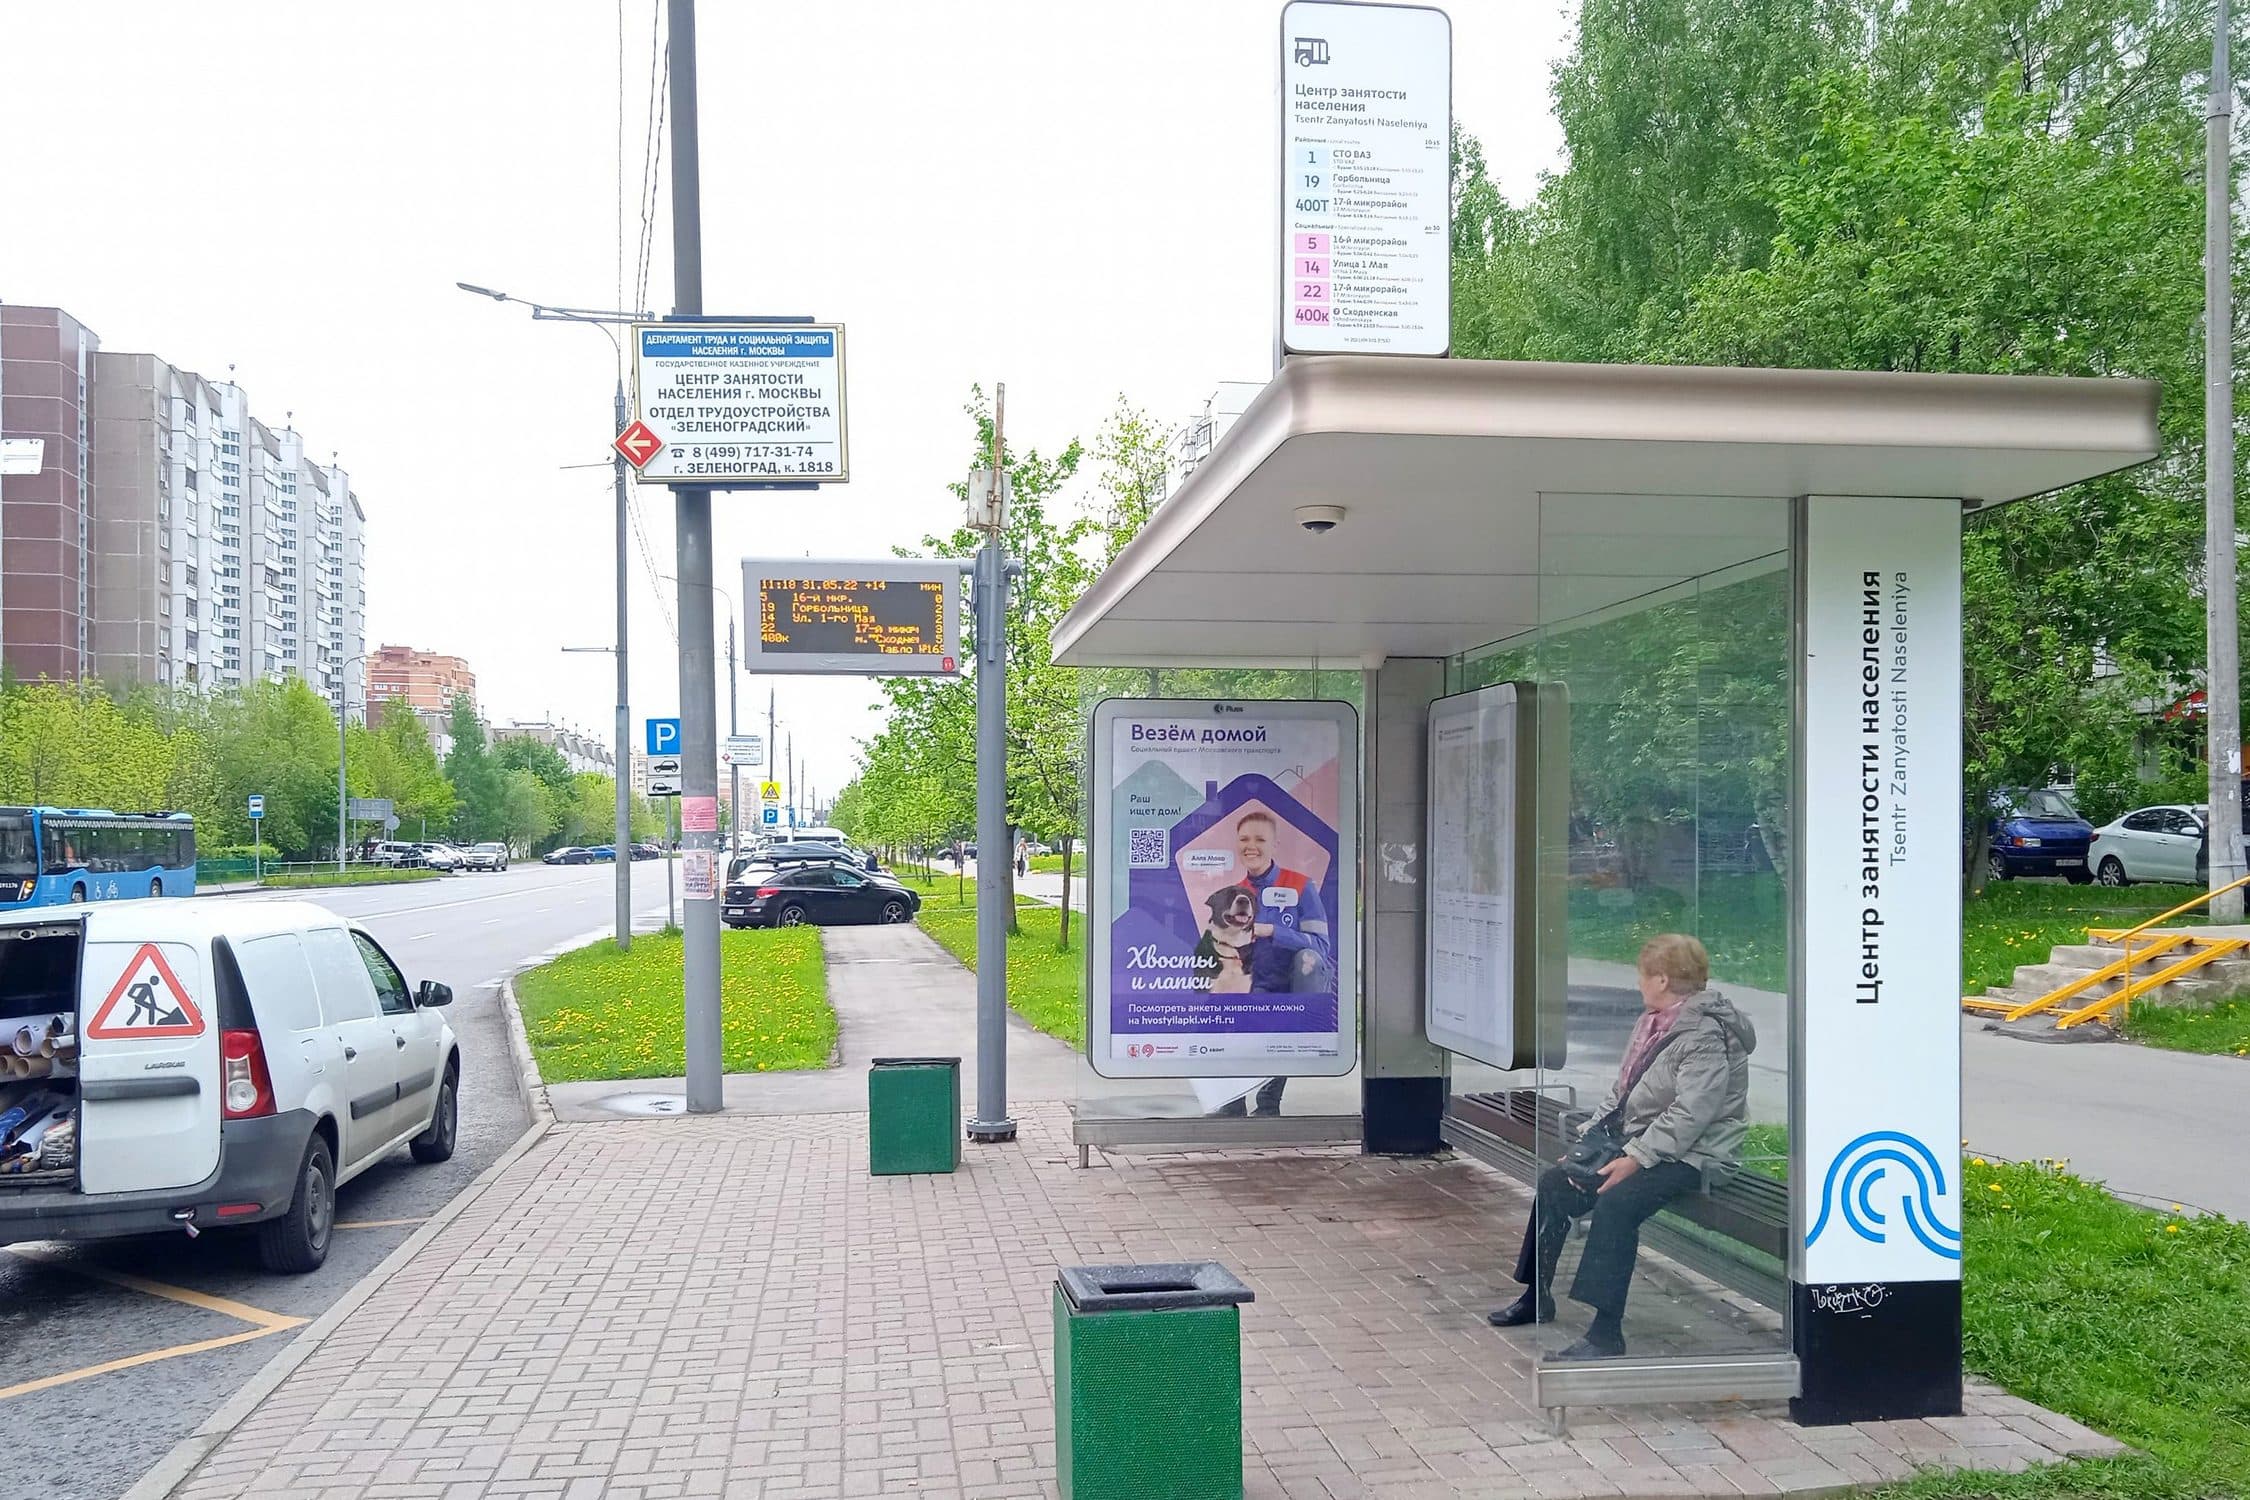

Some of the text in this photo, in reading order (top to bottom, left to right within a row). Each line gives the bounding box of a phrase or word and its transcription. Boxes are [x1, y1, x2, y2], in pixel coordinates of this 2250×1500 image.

[1295, 84, 1407, 100] Центр занятости
[1295, 100, 1366, 112] населения
[1294, 114, 1428, 130] Tsentr Zanyatosti Naseleniya
[1308, 151, 1316, 164] 1
[1332, 150, 1372, 159] СТО ВАЗ
[1304, 175, 1320, 188] 19
[1332, 174, 1390, 184] Горбольница
[1333, 197, 1408, 209] 17-й микрорайон
[1308, 237, 1317, 250] 5
[1333, 235, 1408, 246] 16-й микрорайон
[1305, 260, 1320, 274] 14
[1333, 259, 1388, 269] Улица 1 Мая
[1304, 285, 1322, 298] 22
[1333, 283, 1408, 294] 17-й микрорайон
[1296, 308, 1329, 322] 400к
[1342, 308, 1398, 318] Сходненская
[646, 334, 829, 346] ДЕПАРТАМЕНТ ТРУДА И СОЦИАЛЬНОЙ ЗАЩИТЫ
[692, 346, 738, 356] НАСЕЛЕНИЯ
[749, 346, 785, 356] МОСКВЫ
[656, 360, 728, 368] ГОСУДАРСТВЕННОЕ
[676, 374, 803, 386] ЦЕНТР ЗАНЯТОСТИ
[658, 388, 821, 399] НАСЕЛЕНИЯ г. МОСКВЫ
[650, 404, 830, 420] ОТДЕЛ ТРУДОУСТРОЙСТВА
[671, 418, 811, 433] «ЗЕЛЕНОГРАДСКИЙ»
[692, 446, 813, 460] 8 (499) 717-31-74
[674, 462, 833, 474] г. ЗЕЛЕНОГРАД, к. 1818
[761, 579, 796, 590] 11:18
[802, 580, 858, 590] 31.05.22
[865, 581, 886, 590] +14
[760, 592, 768, 602] 5
[935, 594, 942, 603] 0
[761, 602, 943, 615] 19 Горбольница 2
[761, 612, 943, 624] 14 Ул. 1-го Мая 2
[761, 622, 775, 632] 22
[935, 624, 943, 634] 3
[761, 632, 790, 643] 400к
[935, 634, 943, 644] 5
[879, 644, 913, 654] Табло
[1890, 571, 1910, 866] Tsentr Zanyatosti Naseleniya
[656, 723, 676, 752] P
[1132, 724, 1266, 744] Везём домой
[1856, 570, 1884, 1004] Центр занятости населения
[1130, 794, 1150, 803] Раш
[1130, 808, 1181, 816] ищет дом!
[1126, 944, 1217, 969] Хвосты
[1132, 976, 1214, 990] и лапки
[1128, 1004, 1305, 1014] Посмотреть анкеты животных можно
[1142, 1015, 1234, 1026] hvostyilapki.wi-fi.ru
